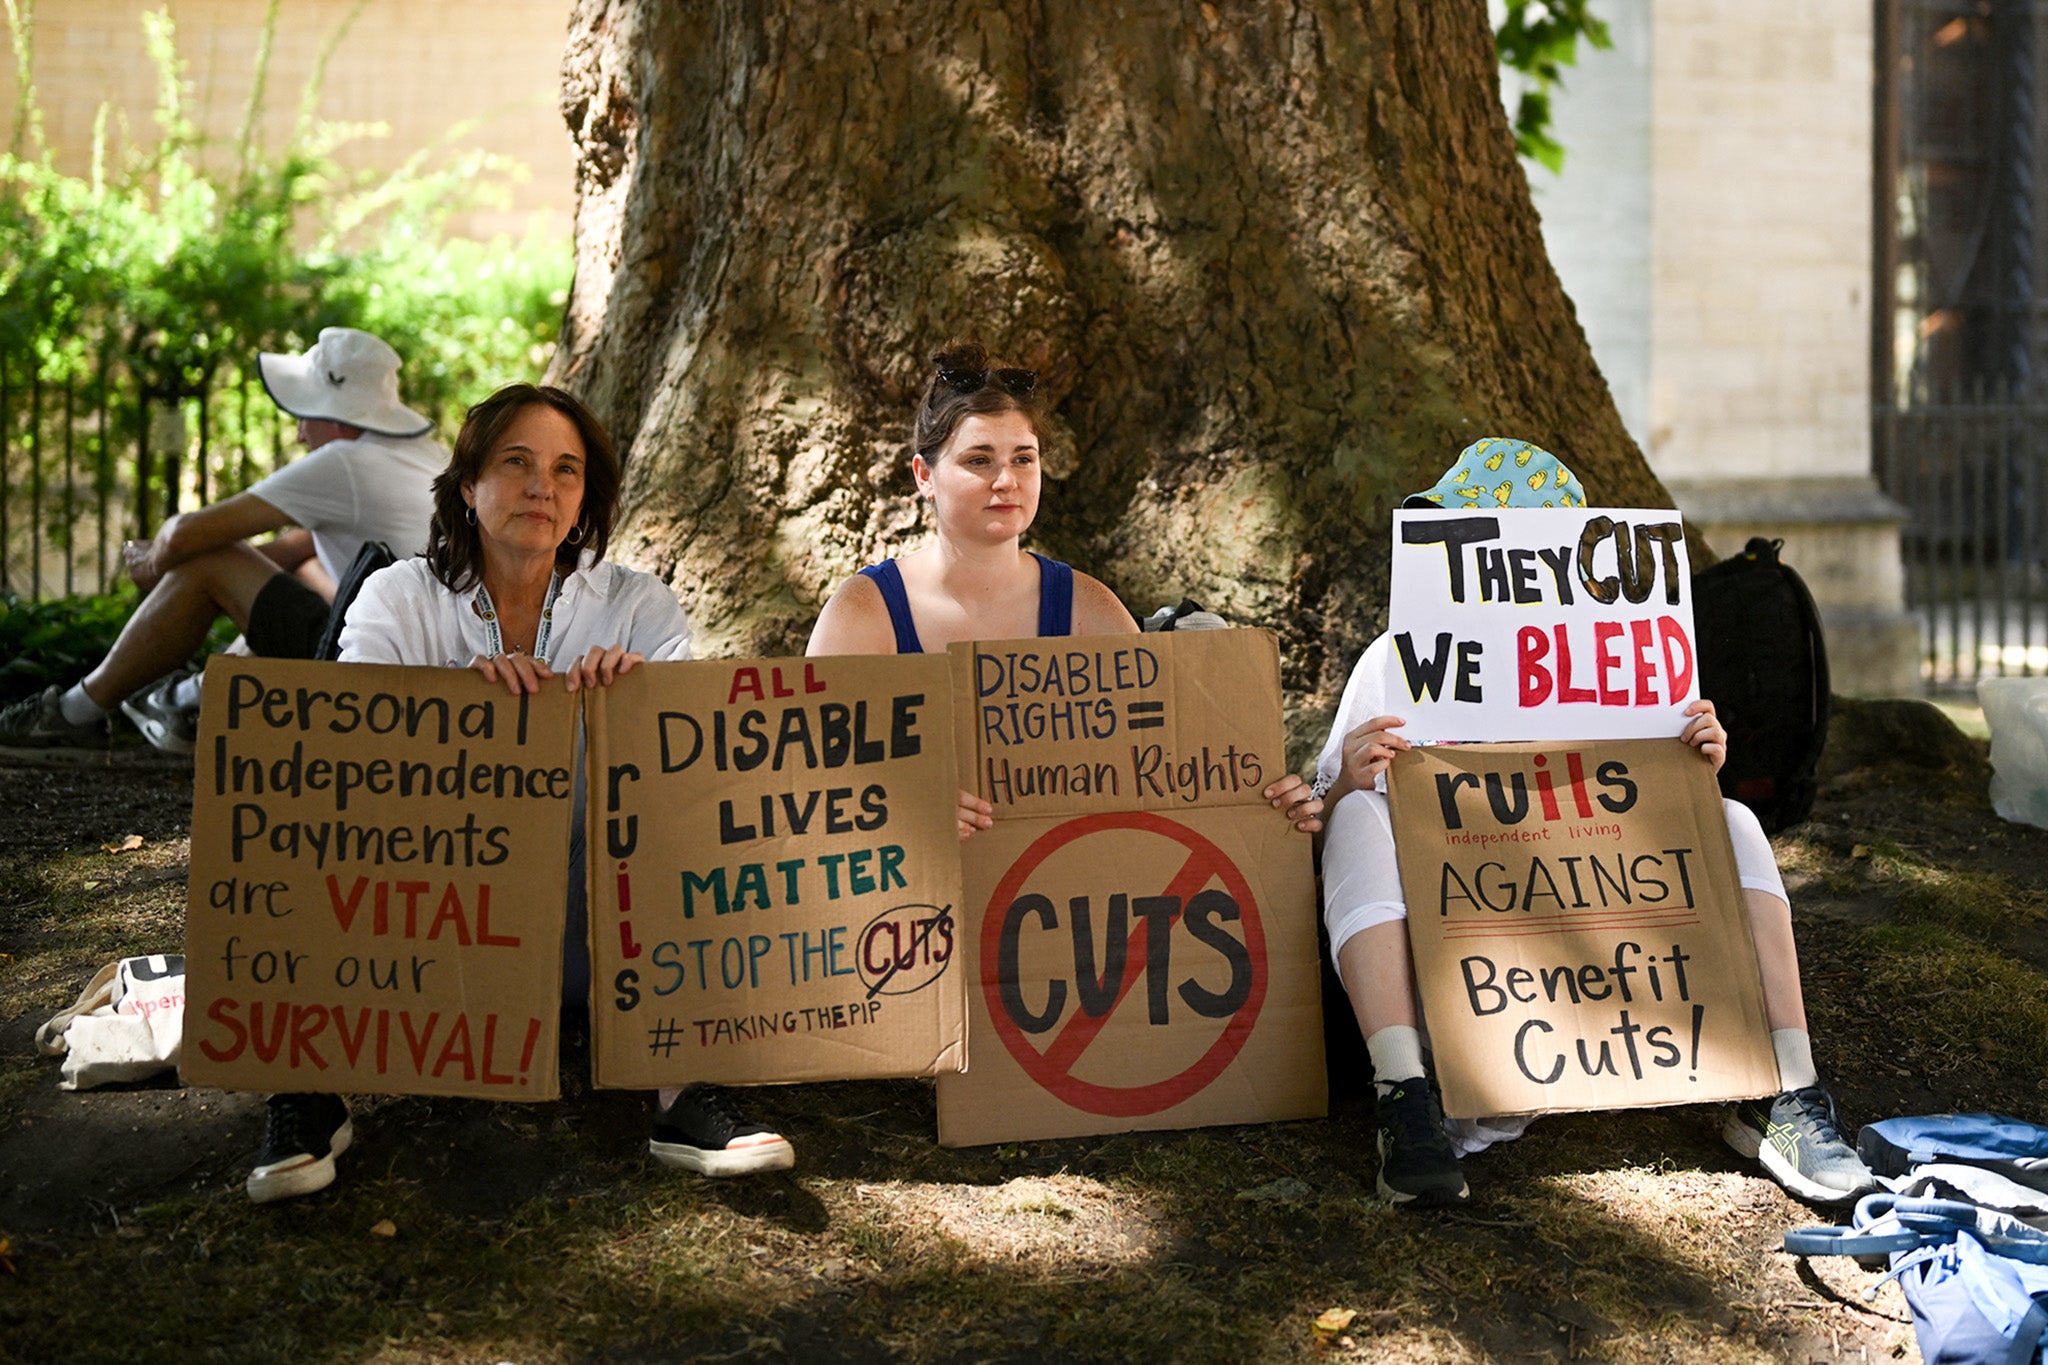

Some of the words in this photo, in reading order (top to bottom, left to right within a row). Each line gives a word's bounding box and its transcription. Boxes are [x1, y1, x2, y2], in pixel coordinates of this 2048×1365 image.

[1401, 516, 1574, 606] THEY
[1577, 515, 1683, 606] CUT
[728, 663, 826, 704] ALL
[976, 648, 1159, 698] DISABLED
[1393, 632, 1484, 705] WE
[1517, 615, 1693, 707] BLEED
[228, 674, 529, 746] Personal
[658, 694, 925, 773] DISABLE
[982, 698, 1117, 746] RIGHTS
[215, 736, 570, 811] Independence
[986, 757, 1120, 804] Human
[1131, 744, 1263, 802] Rights
[1434, 752, 1638, 830] ruils
[232, 803, 511, 869] Payments
[719, 784, 889, 845] LIVES
[1445, 827, 1551, 850] independent
[1569, 823, 1622, 841] living
[210, 877, 294, 918] are
[325, 874, 521, 947] VITAL
[680, 845, 908, 919] MATTER
[1440, 848, 1693, 917] AGAINST
[220, 936, 309, 984] for
[335, 955, 436, 992] our
[652, 935, 771, 996] STOP
[779, 926, 855, 987] THE
[863, 915, 954, 976] CUTS
[1000, 889, 1254, 1035] CUTS
[1460, 941, 1692, 1017] Benefit
[200, 997, 541, 1086] SURVIVAL!
[1513, 1004, 1704, 1084] Cuts!
